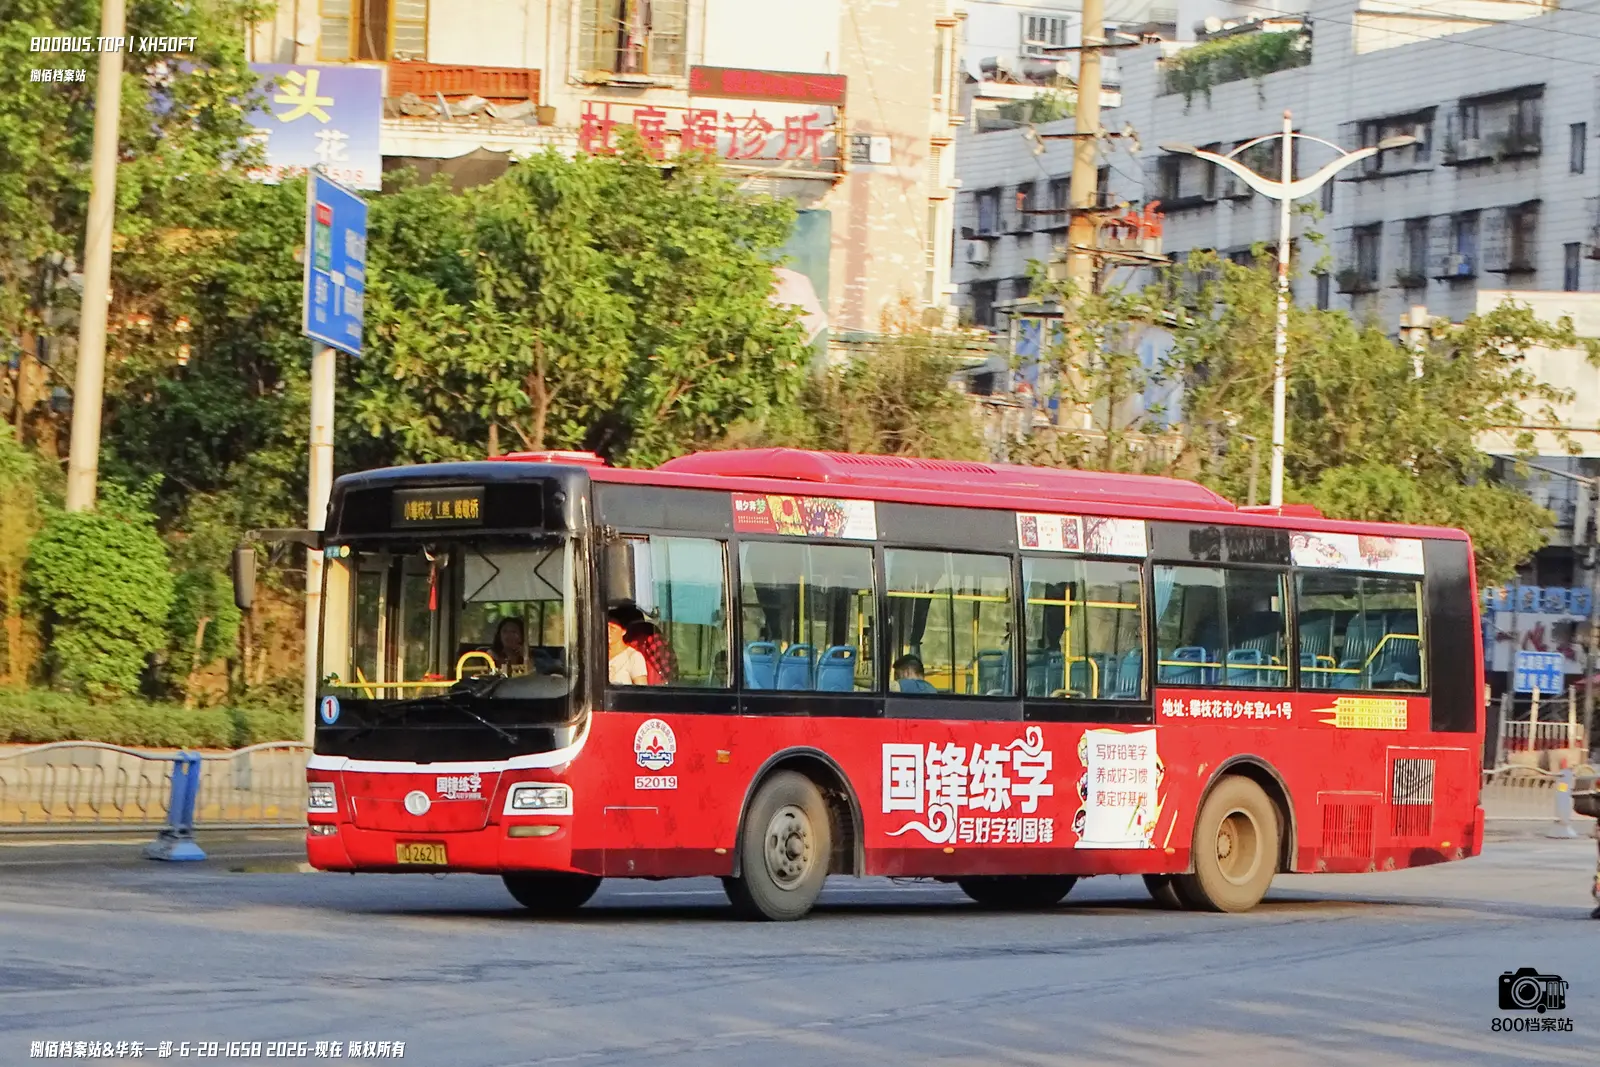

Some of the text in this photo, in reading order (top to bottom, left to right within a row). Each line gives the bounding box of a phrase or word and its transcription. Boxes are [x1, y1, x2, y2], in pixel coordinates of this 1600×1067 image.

[273, 69, 334, 123] 头
[314, 129, 350, 162] 花
[1096, 744, 1148, 760] 写好铅笔字
[882, 726, 1054, 814] 国锋练字
[1096, 767, 1148, 784] 养成好习惯
[636, 776, 676, 788] 52019
[1096, 791, 1148, 807] 奠定好基础
[959, 817, 1054, 843] 写好字到国锋
